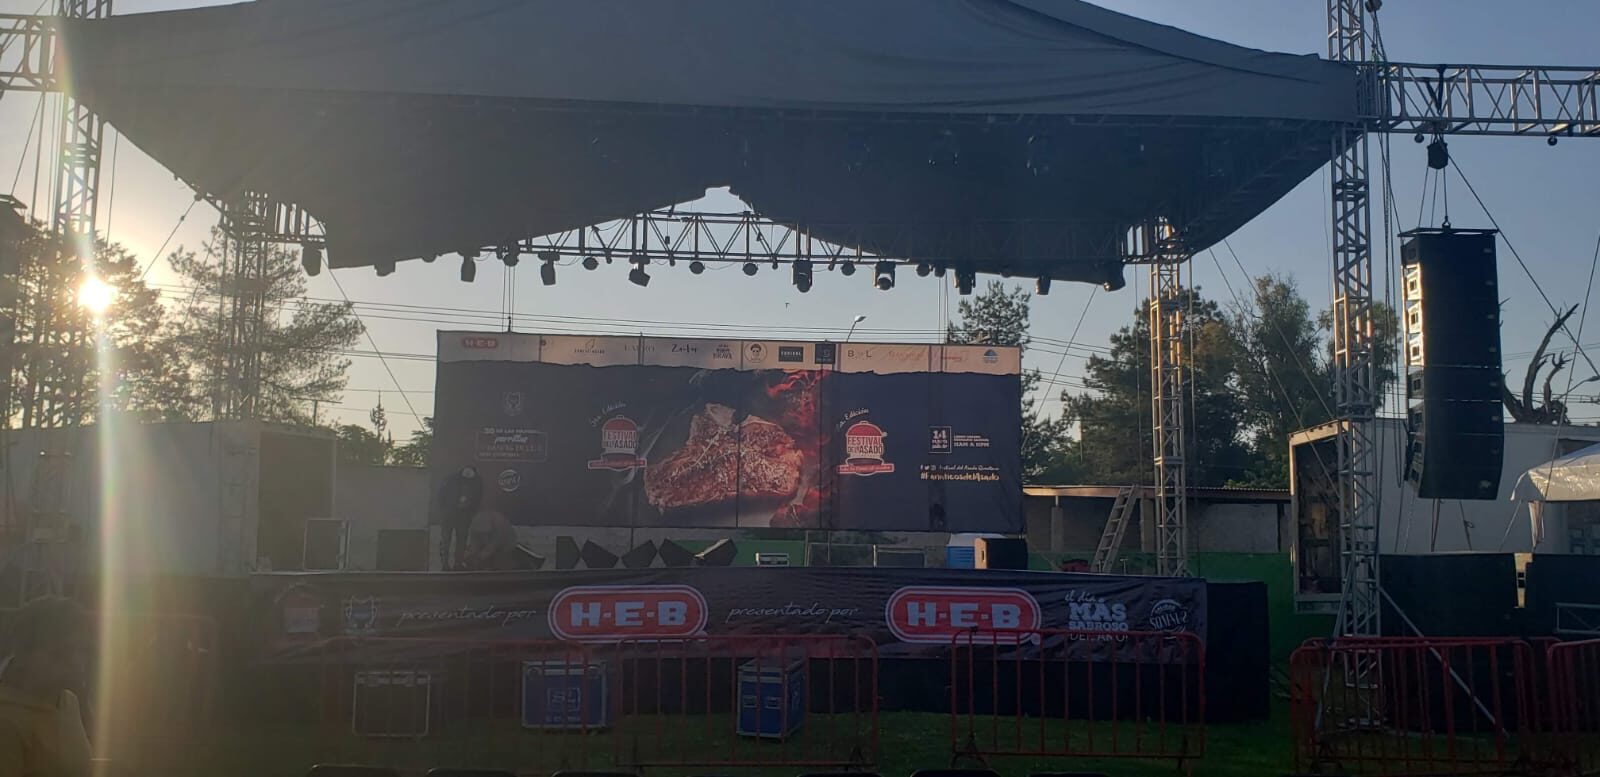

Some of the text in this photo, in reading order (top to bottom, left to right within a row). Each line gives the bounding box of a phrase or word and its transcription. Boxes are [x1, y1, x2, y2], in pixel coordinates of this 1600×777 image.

[847, 436, 882, 445] FESTIVAL
[859, 445, 883, 454] ASADO
[1064, 589, 1075, 602] el
[396, 604, 537, 627] presentado por
[570, 601, 688, 627] H-E-B
[725, 602, 859, 625] presentado por
[907, 601, 1022, 629] H-E-B
[1068, 598, 1128, 622] MÁS
[1068, 621, 1129, 632] SABROSO
